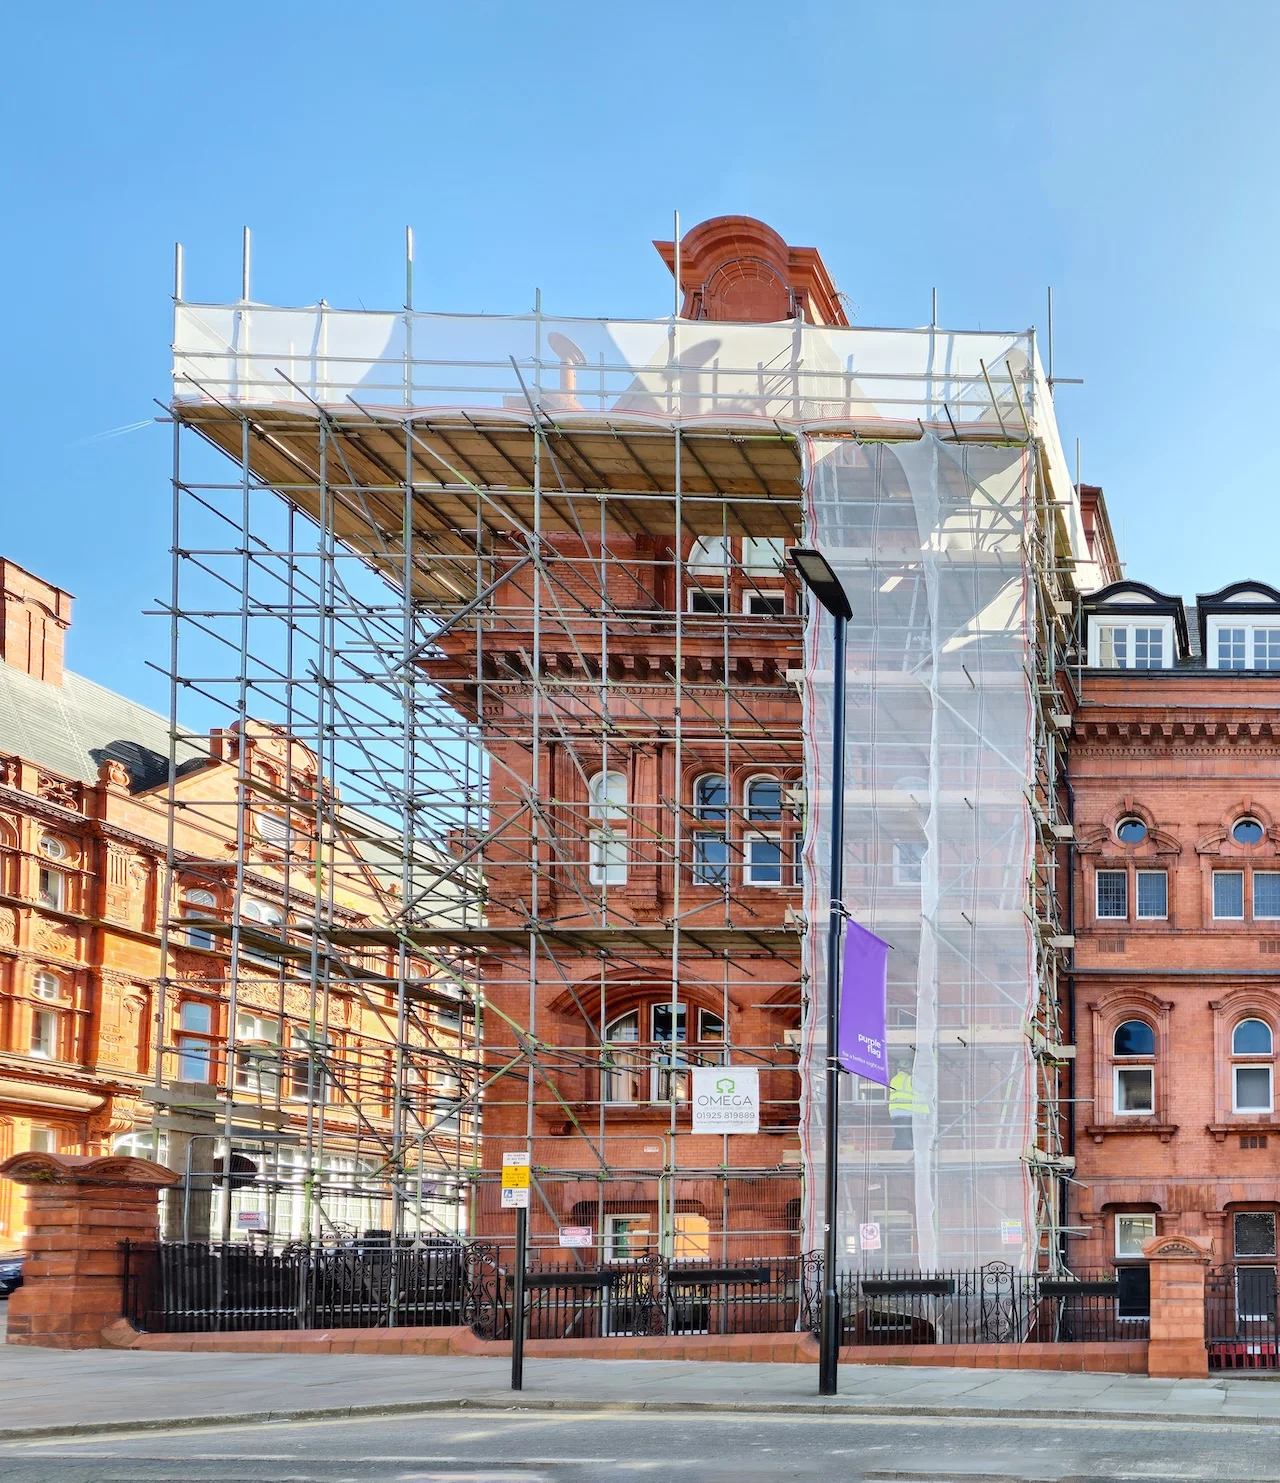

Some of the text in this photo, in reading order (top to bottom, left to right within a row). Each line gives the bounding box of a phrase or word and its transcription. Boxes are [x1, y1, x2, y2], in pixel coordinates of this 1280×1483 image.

[857, 1033, 881, 1048] purple
[867, 1044, 881, 1059] flag
[697, 1095, 753, 1106] OMEGA
